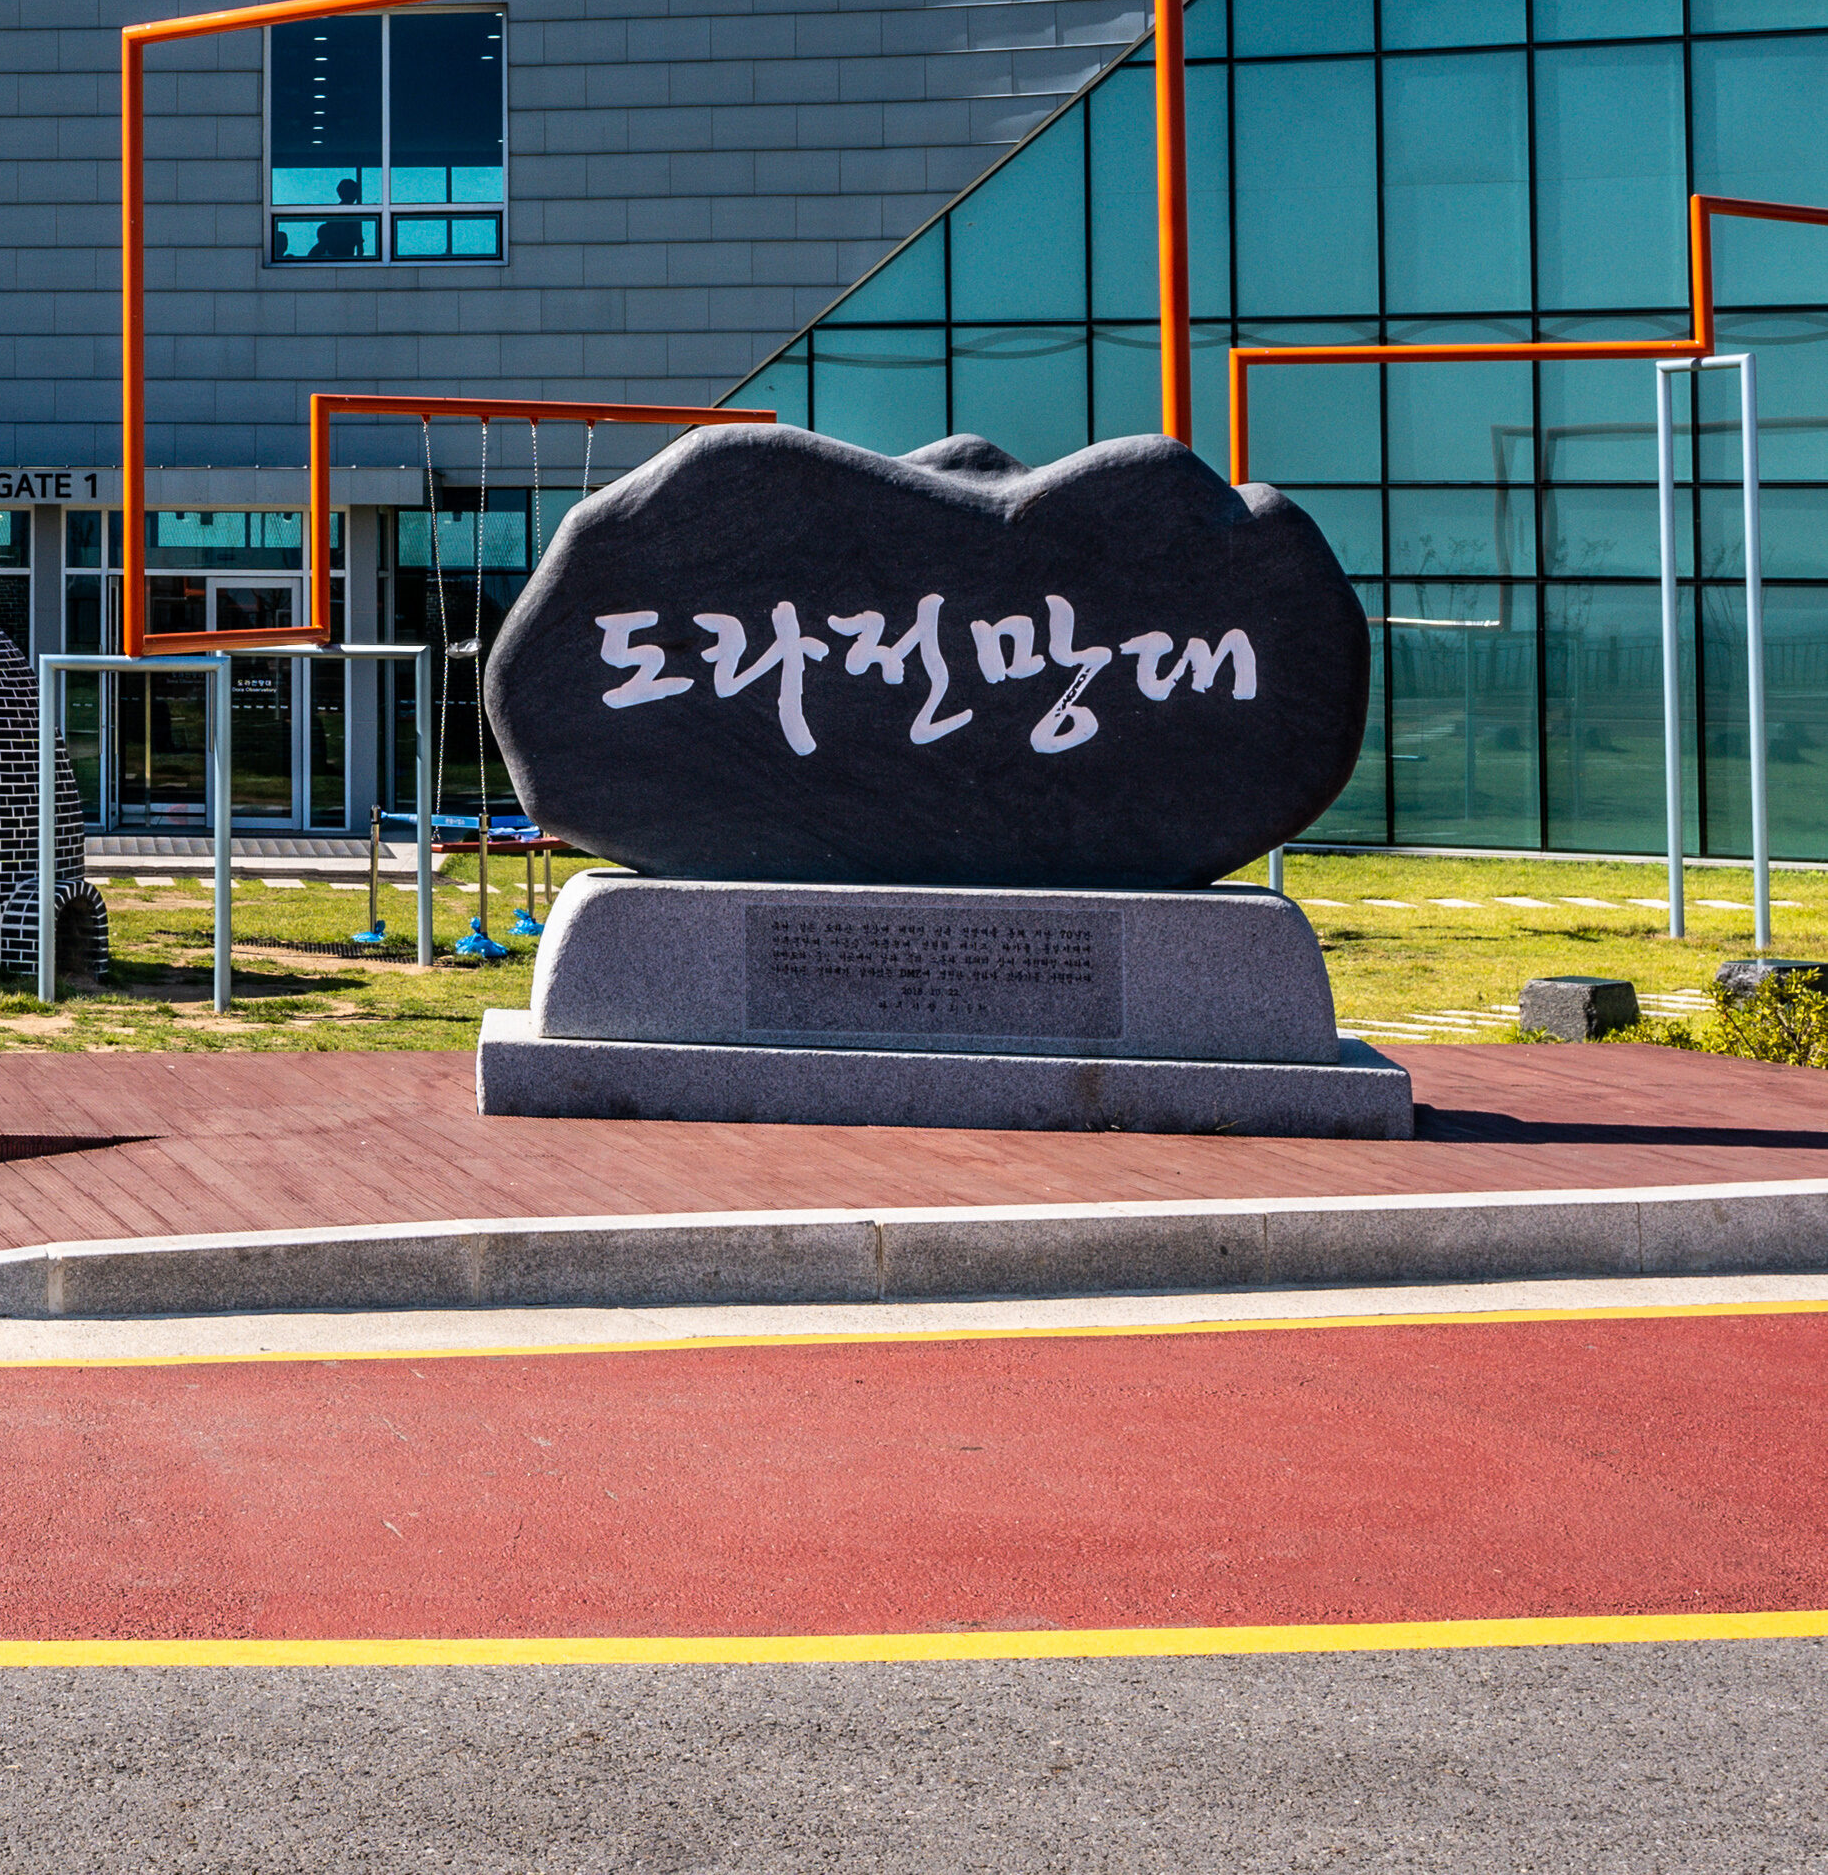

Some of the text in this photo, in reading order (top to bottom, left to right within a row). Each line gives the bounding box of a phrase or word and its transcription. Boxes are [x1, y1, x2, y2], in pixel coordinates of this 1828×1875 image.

[84, 472, 98, 499] 1
[237, 679, 272, 687] 도라전망대
[594, 592, 1257, 757] 도라전망대
